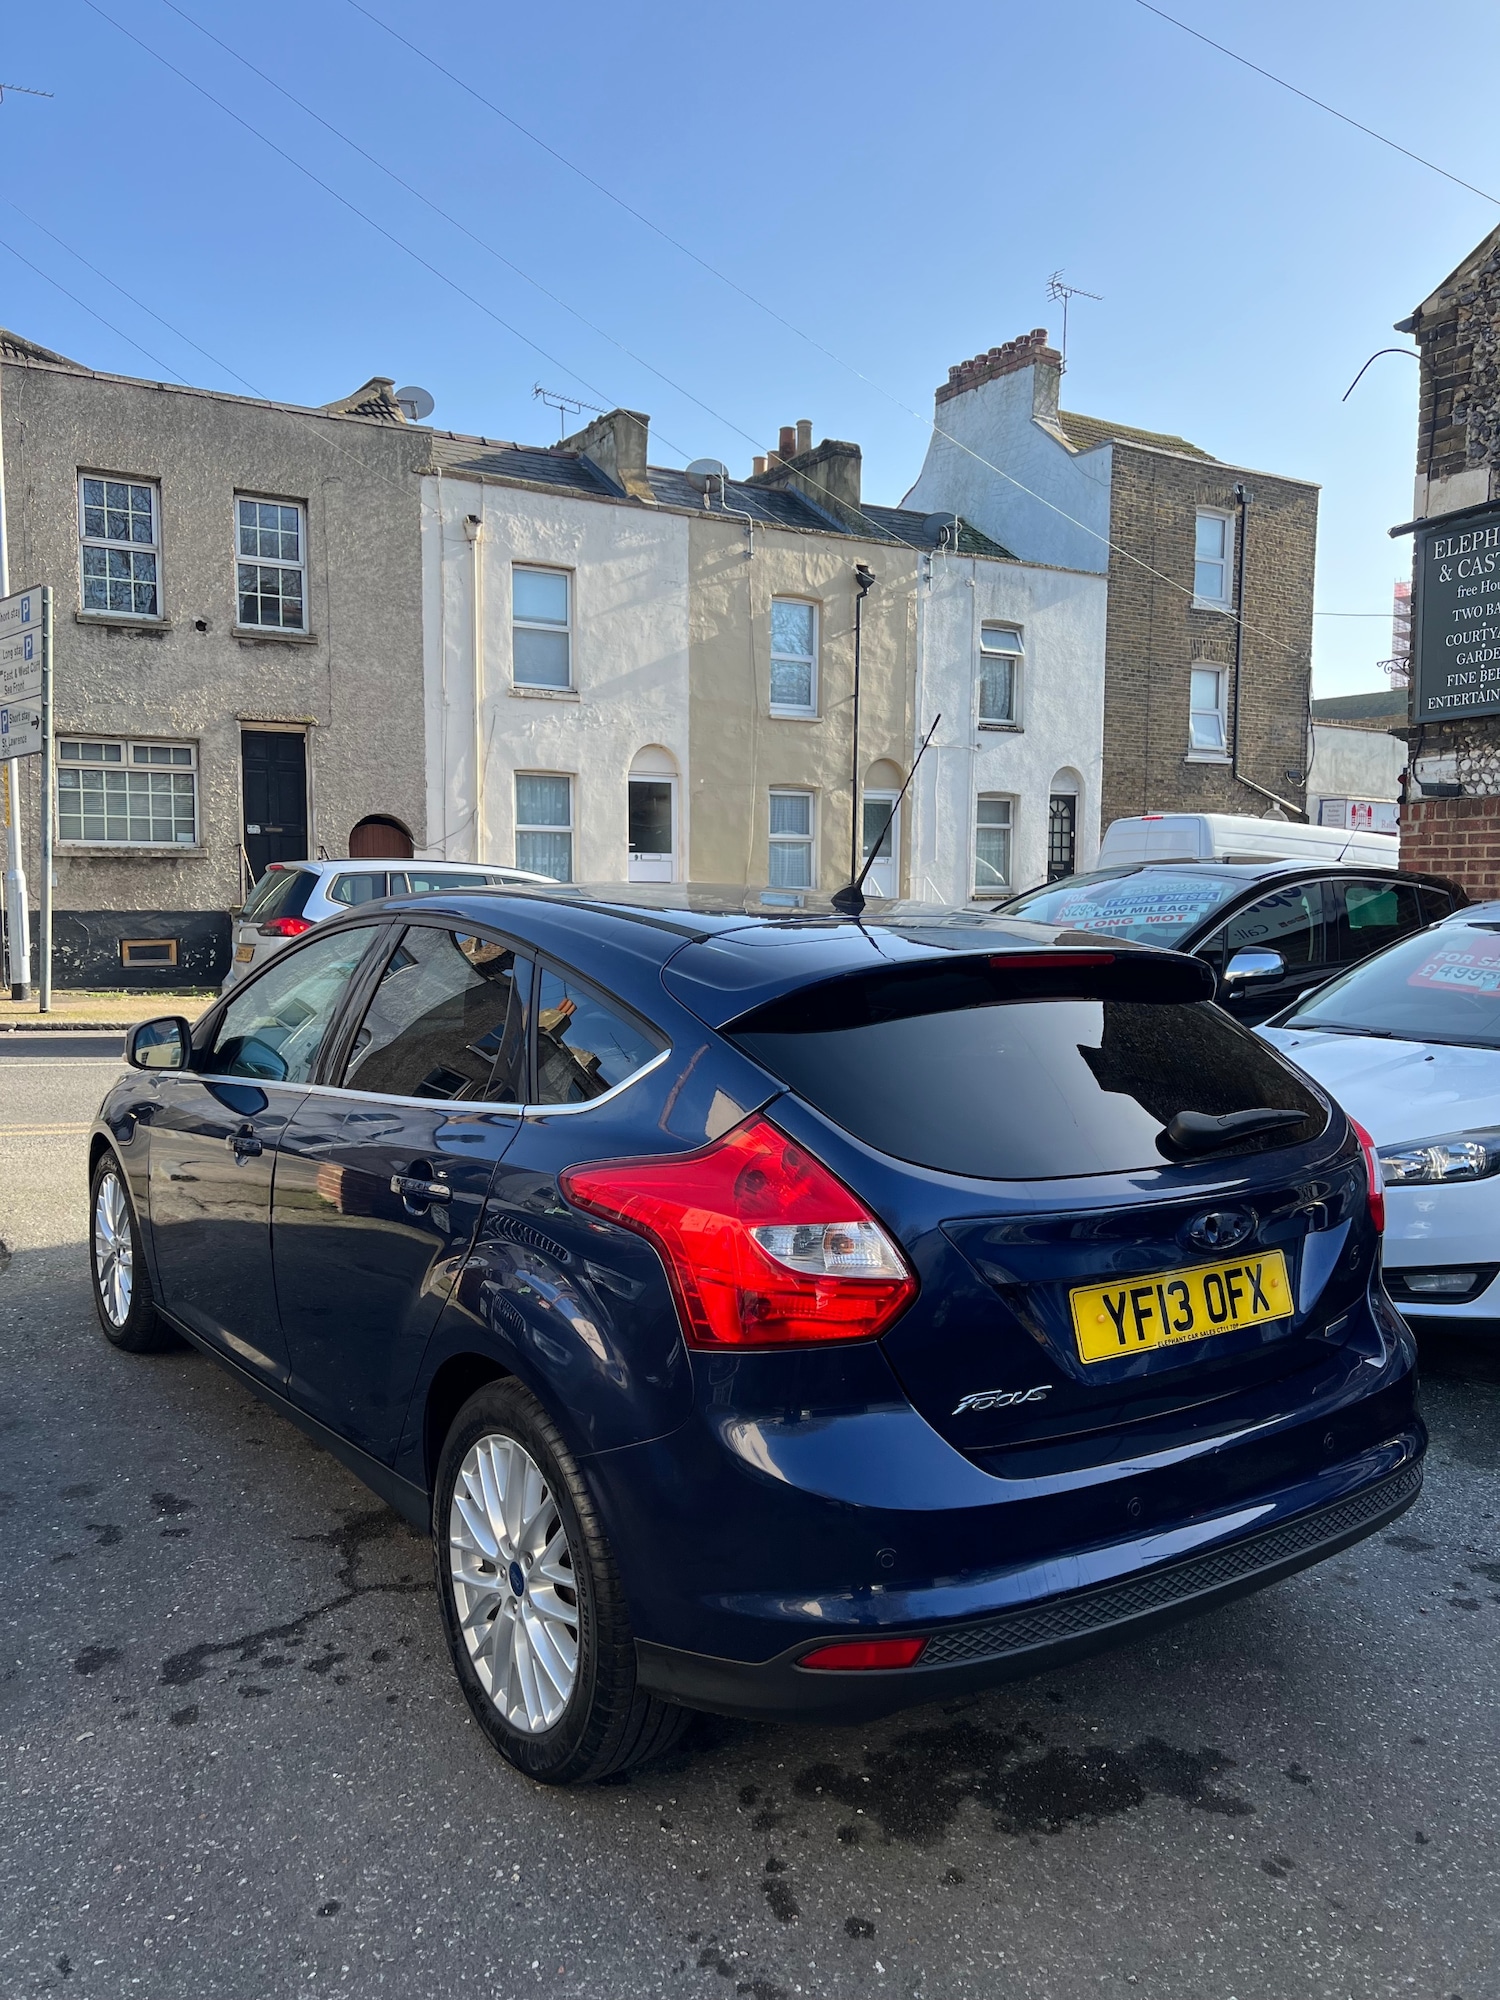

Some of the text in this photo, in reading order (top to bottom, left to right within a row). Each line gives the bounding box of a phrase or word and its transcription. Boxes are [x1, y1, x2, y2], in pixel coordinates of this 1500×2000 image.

[1433, 526, 1500, 560] ELEPH
[1439, 564, 1453, 583] &
[1457, 585, 1478, 598] free
[22, 598, 29, 622] P
[1452, 605, 1483, 622] TWO
[3, 636, 32, 660] Long stay P
[3, 670, 14, 681] East
[18, 664, 30, 677] West
[30, 660, 40, 673] Cliff
[1446, 671, 1477, 687] FINE
[4, 680, 25, 696] Sea Front
[2, 710, 31, 732] P Short stay
[8, 734, 27, 747] Lawrence
[1108, 893, 1216, 907] TURBO DIESEL
[1094, 904, 1198, 918] LOW MILEAGE
[1084, 915, 1188, 929] LONG MOT
[1433, 951, 1475, 964] FOR
[1102, 1263, 1271, 1345] YF13 OFX
[1157, 1335, 1186, 1348] ELEPHANT
[1187, 1332, 1199, 1340] CAR
[1199, 1328, 1216, 1337] SALES
